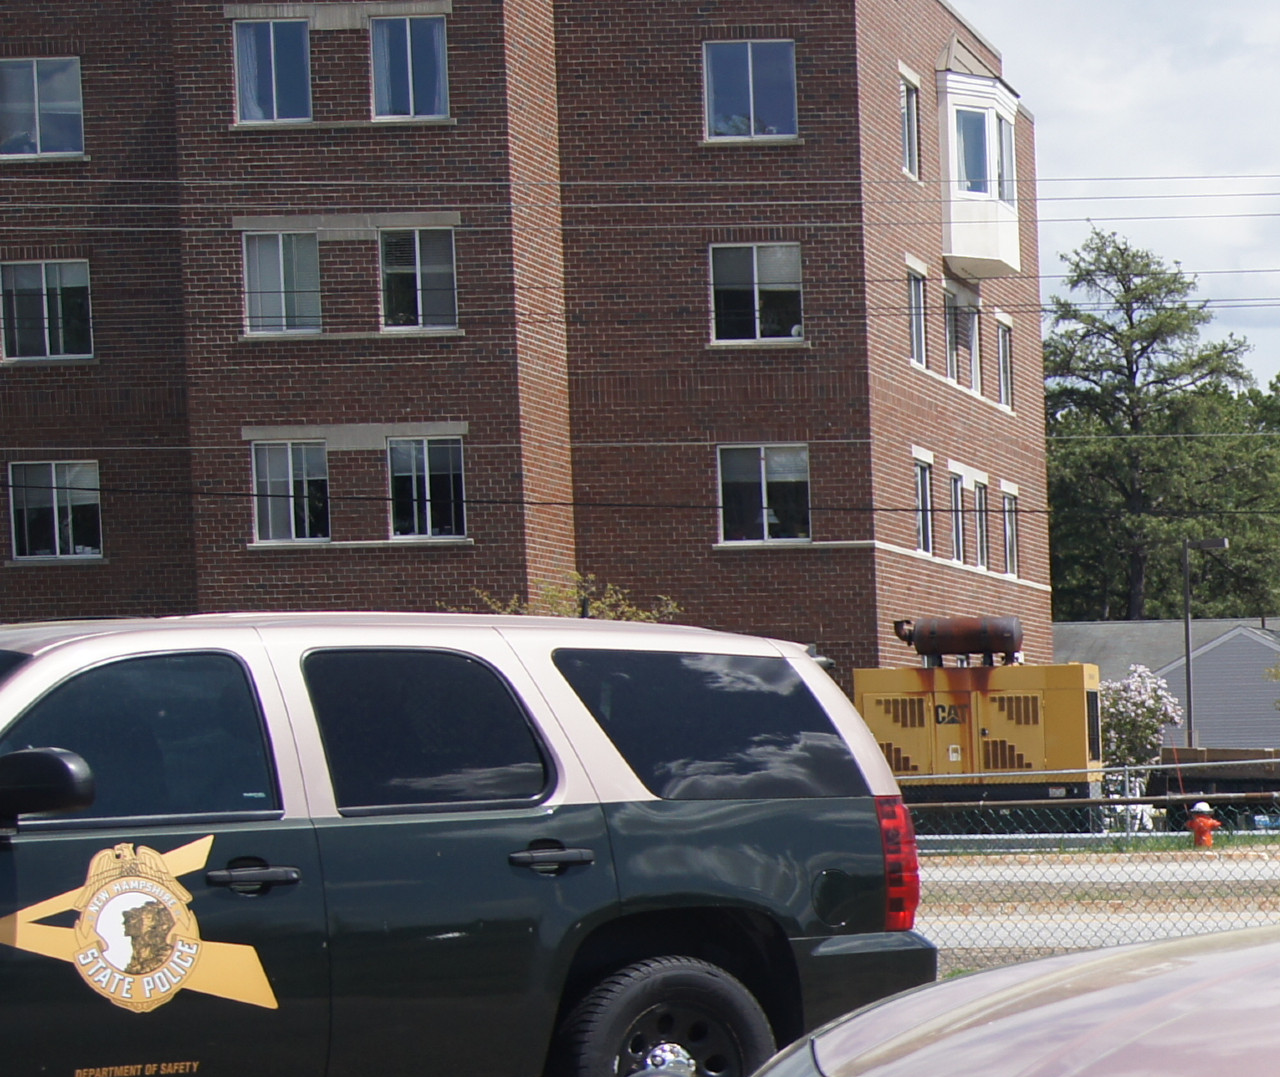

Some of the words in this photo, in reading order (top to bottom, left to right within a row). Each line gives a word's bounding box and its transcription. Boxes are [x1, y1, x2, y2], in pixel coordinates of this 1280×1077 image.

[935, 704, 969, 724] CAT
[88, 889, 110, 913] NEW
[113, 880, 177, 908] HAMPSHIRE
[78, 948, 134, 998] STATE
[142, 940, 199, 998] POLICE
[145, 1063, 158, 1076] OF
[160, 1061, 199, 1075] SAFETY
